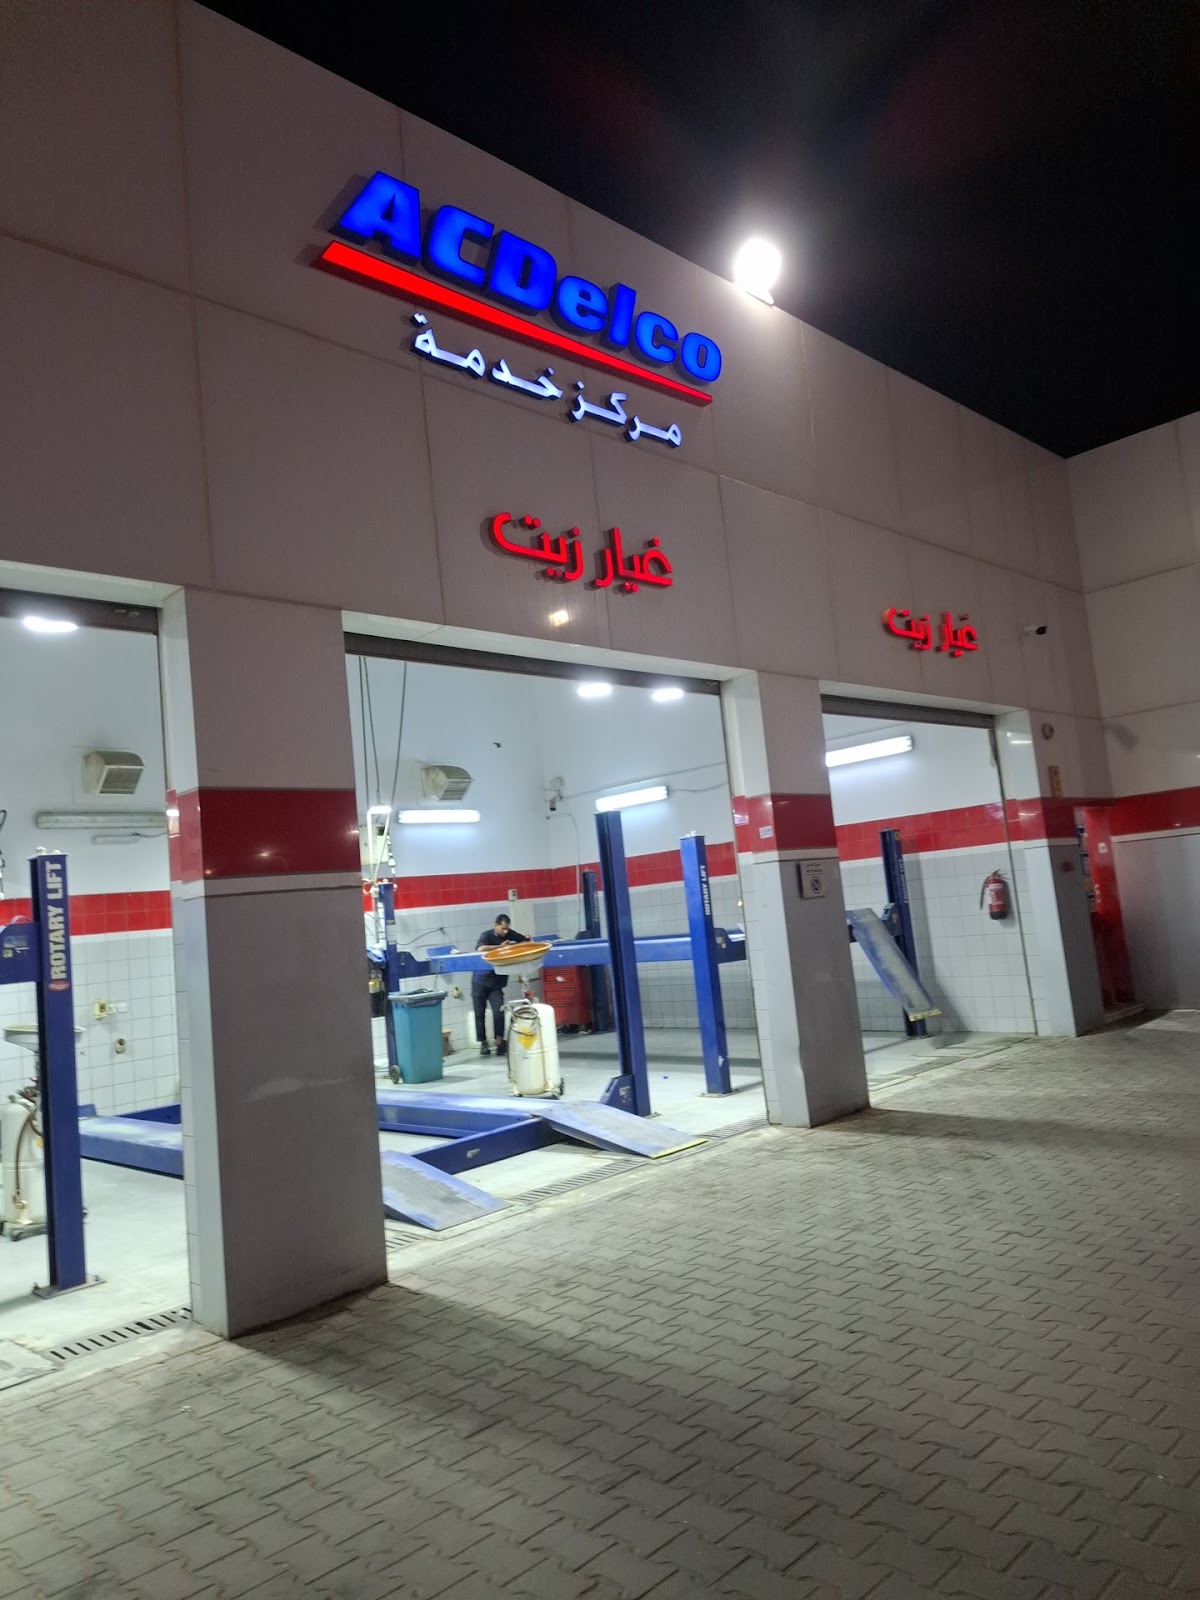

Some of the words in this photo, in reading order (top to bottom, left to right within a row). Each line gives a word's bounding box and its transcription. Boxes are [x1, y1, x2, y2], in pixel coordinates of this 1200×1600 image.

[334, 171, 722, 383] ACDelco
[412, 312, 563, 400] خدمة
[567, 381, 683, 449] مركز
[489, 512, 584, 581] زيت
[592, 527, 673, 594] غيار
[883, 607, 932, 651] زيت
[938, 611, 979, 658] غيار
[45, 860, 63, 899] LIFT
[47, 904, 67, 979] ROTARY
